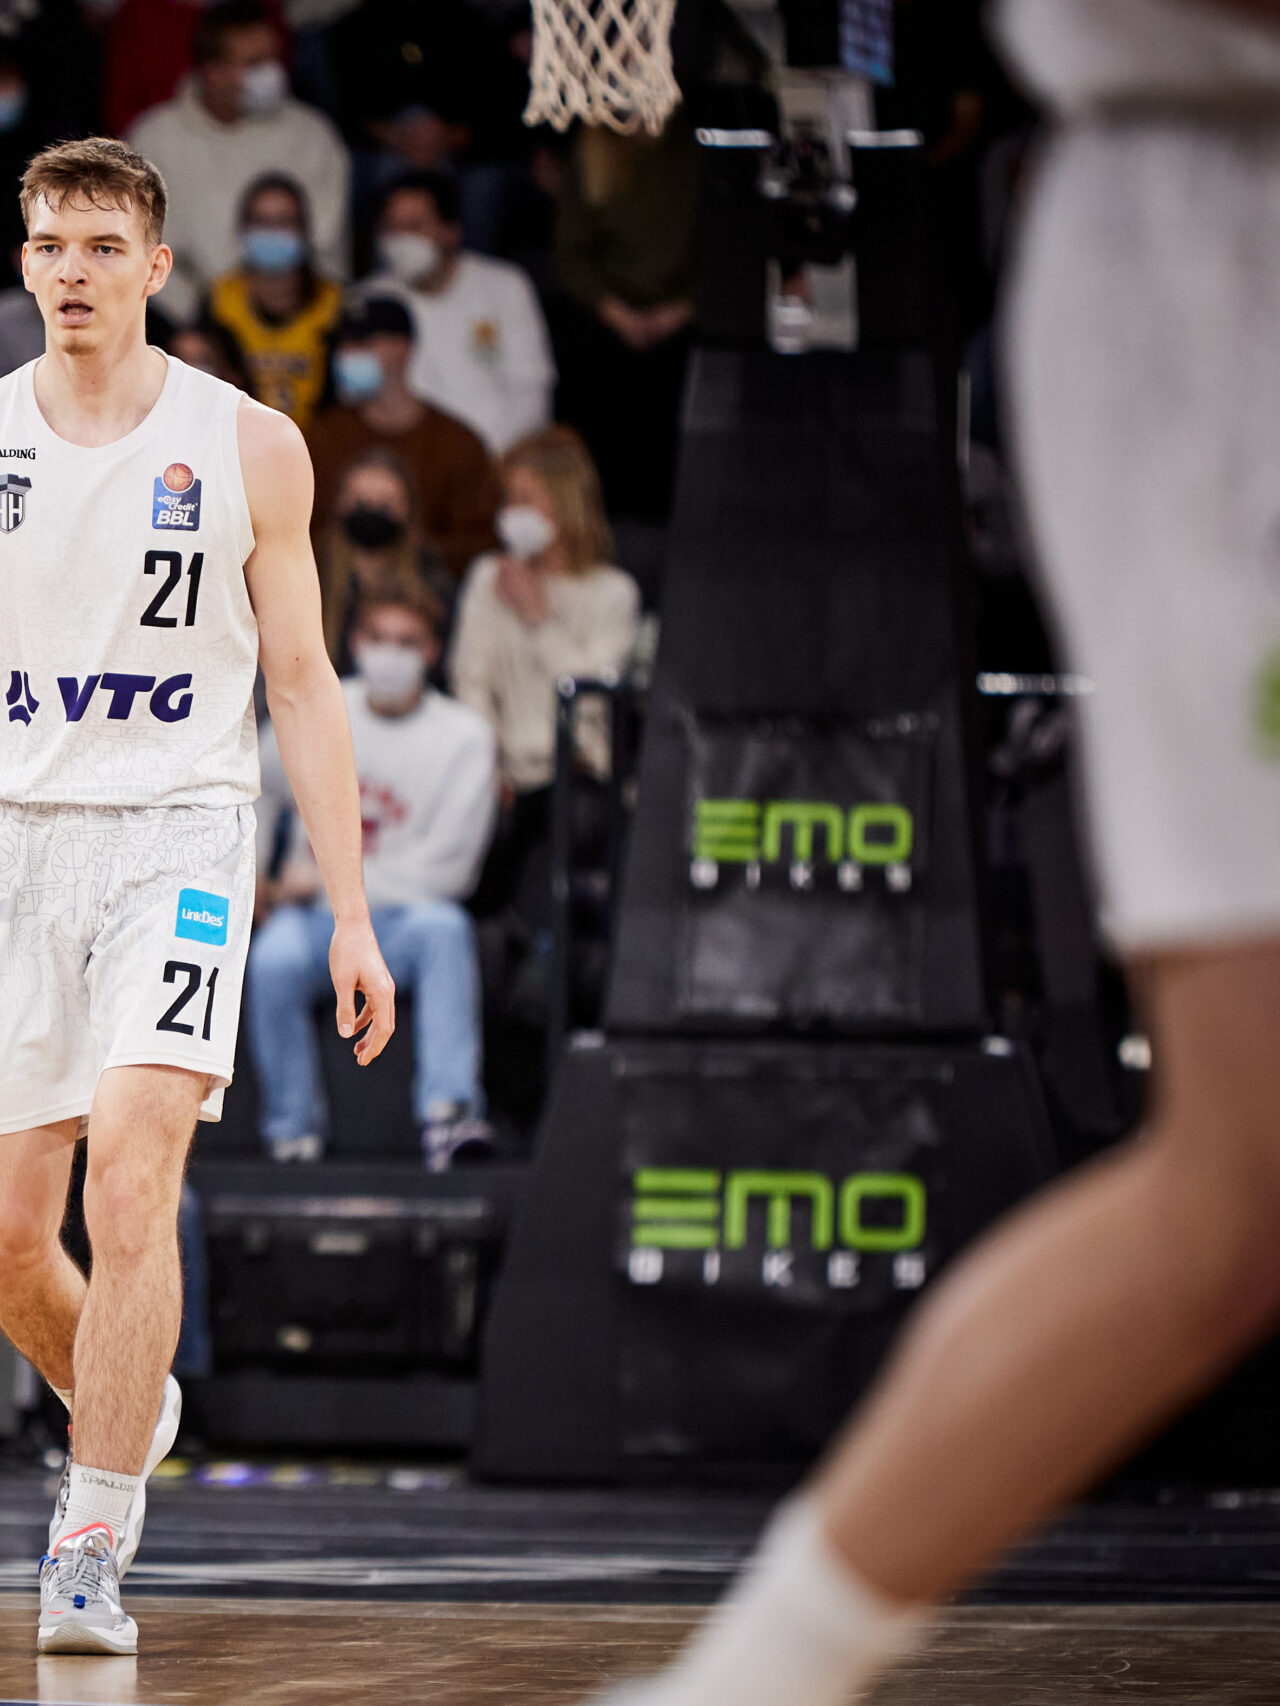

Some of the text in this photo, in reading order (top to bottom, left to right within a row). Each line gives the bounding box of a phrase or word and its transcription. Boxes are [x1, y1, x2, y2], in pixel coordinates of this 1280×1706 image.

[157, 510, 194, 526] BBL
[140, 550, 204, 627] 21
[57, 672, 194, 723] VTG
[692, 800, 913, 863] EMO
[181, 907, 225, 927] LinkDes
[156, 960, 219, 1041] 21
[632, 1168, 926, 1252] EMO
[628, 1248, 926, 1288] BIKES
